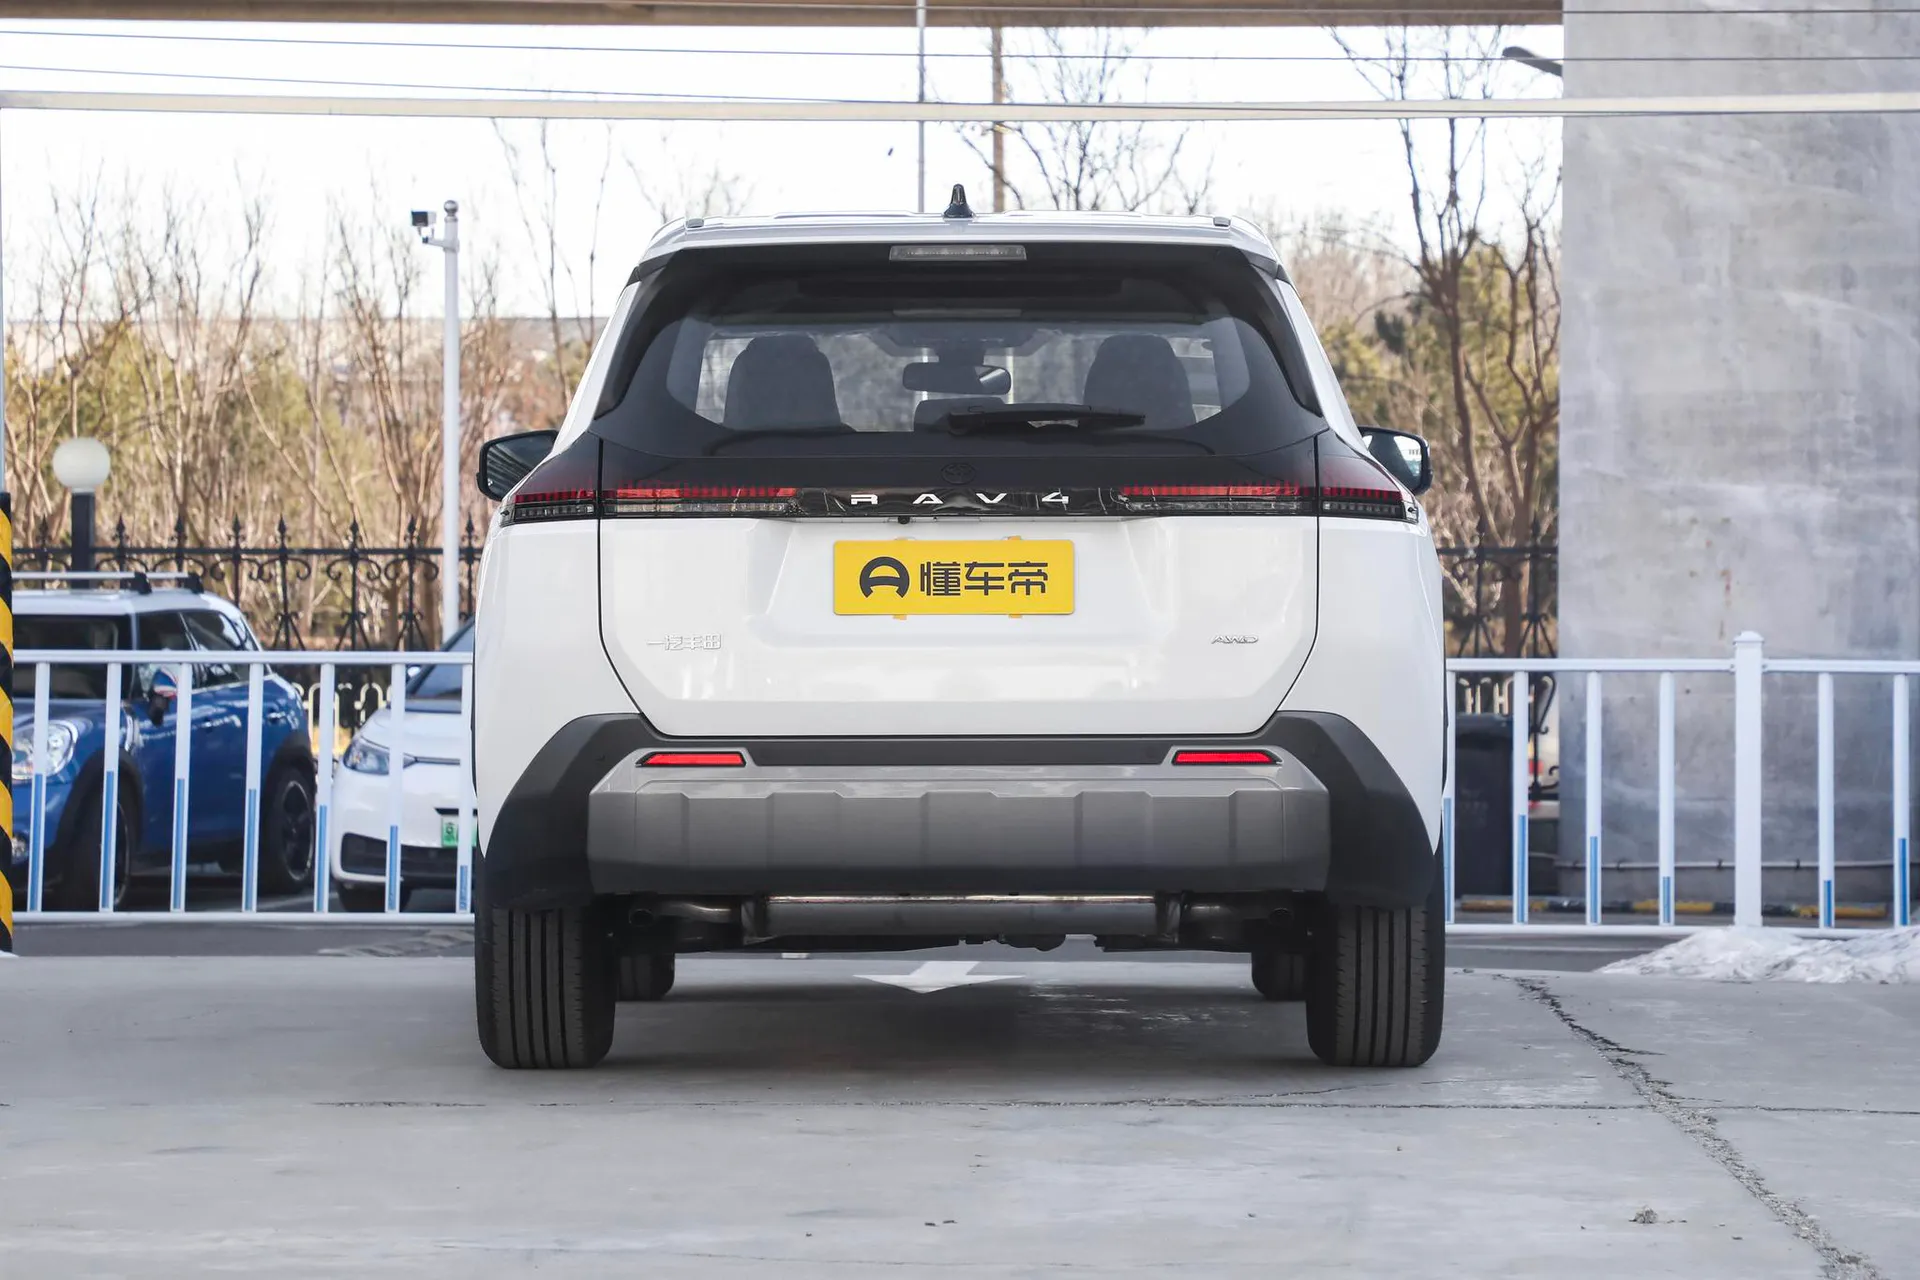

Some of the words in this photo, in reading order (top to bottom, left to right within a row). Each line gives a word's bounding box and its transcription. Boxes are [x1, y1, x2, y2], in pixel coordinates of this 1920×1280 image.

[851, 492, 1069, 505] RAV4
[920, 561, 1049, 596] 懂车帝
[1211, 634, 1259, 645] AWD
